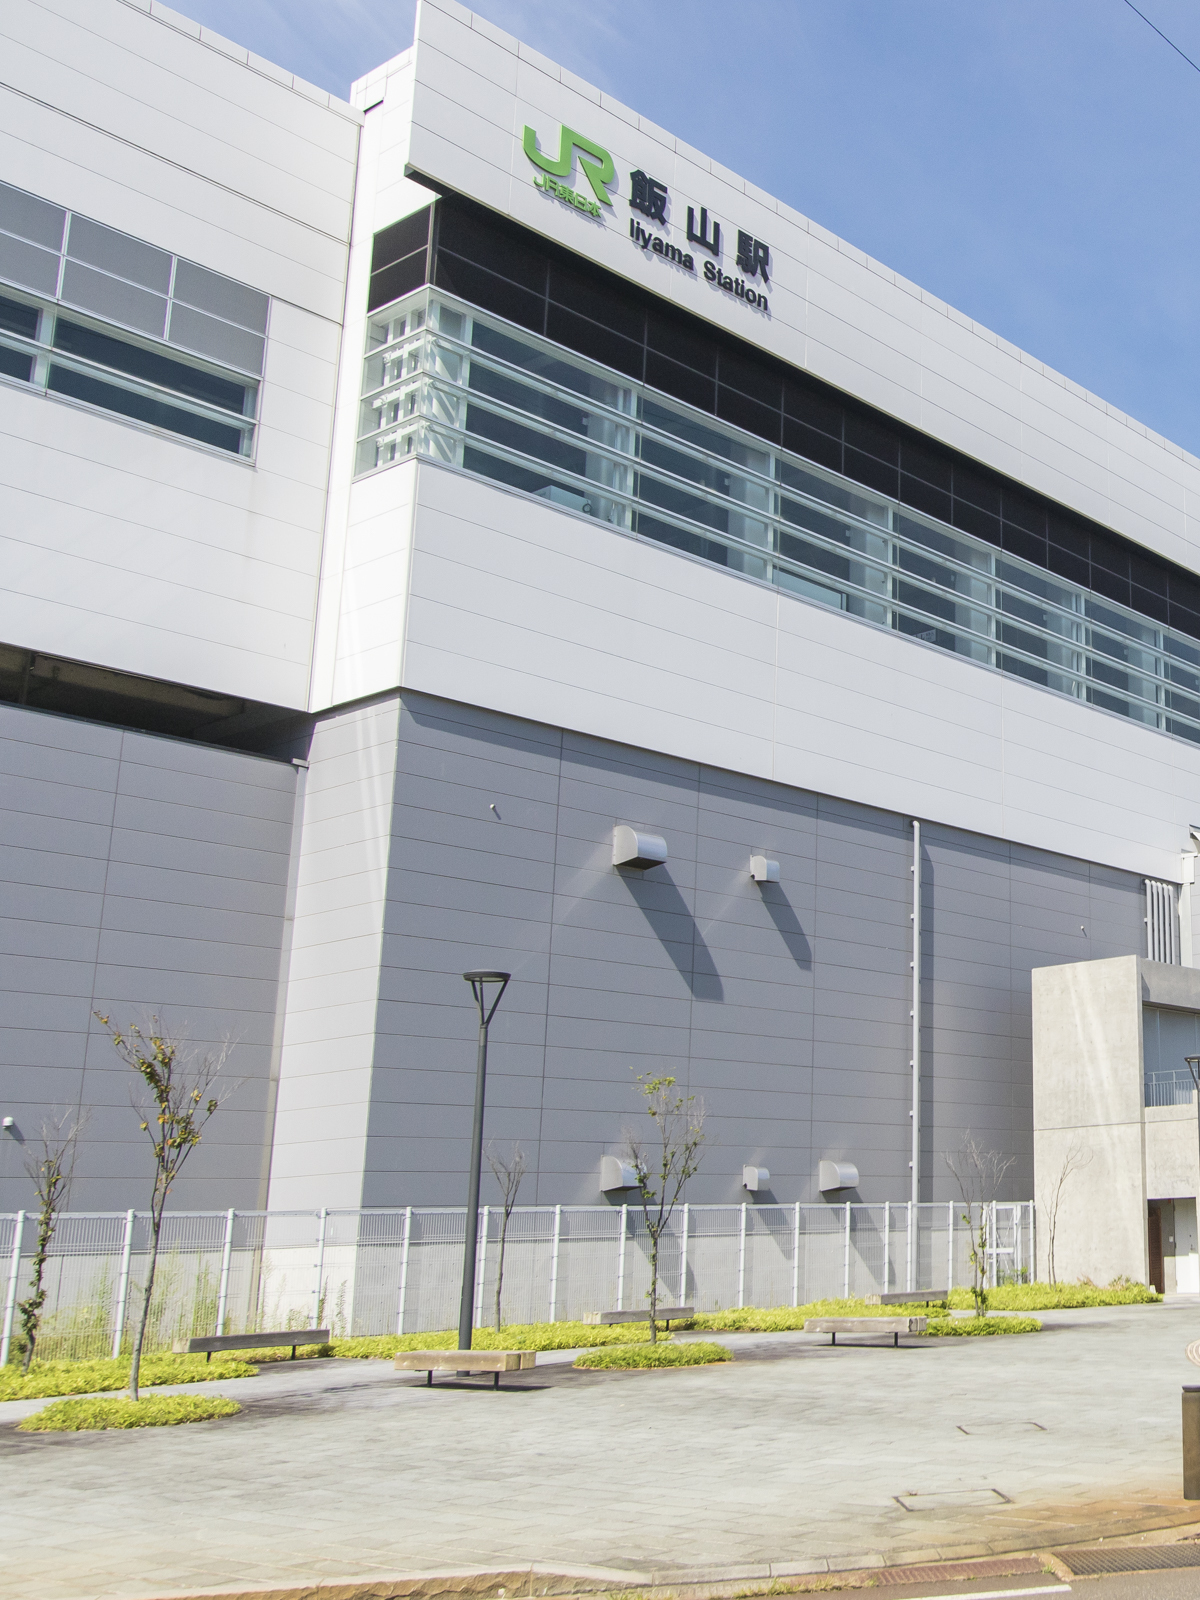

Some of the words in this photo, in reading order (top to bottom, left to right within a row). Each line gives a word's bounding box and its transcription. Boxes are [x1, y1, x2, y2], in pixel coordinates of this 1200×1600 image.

[523, 124, 615, 206] JR
[533, 173, 601, 217] JR東日本
[629, 169, 769, 283] 飯山駅
[629, 217, 694, 271] Iiyama
[703, 260, 768, 311] Station
